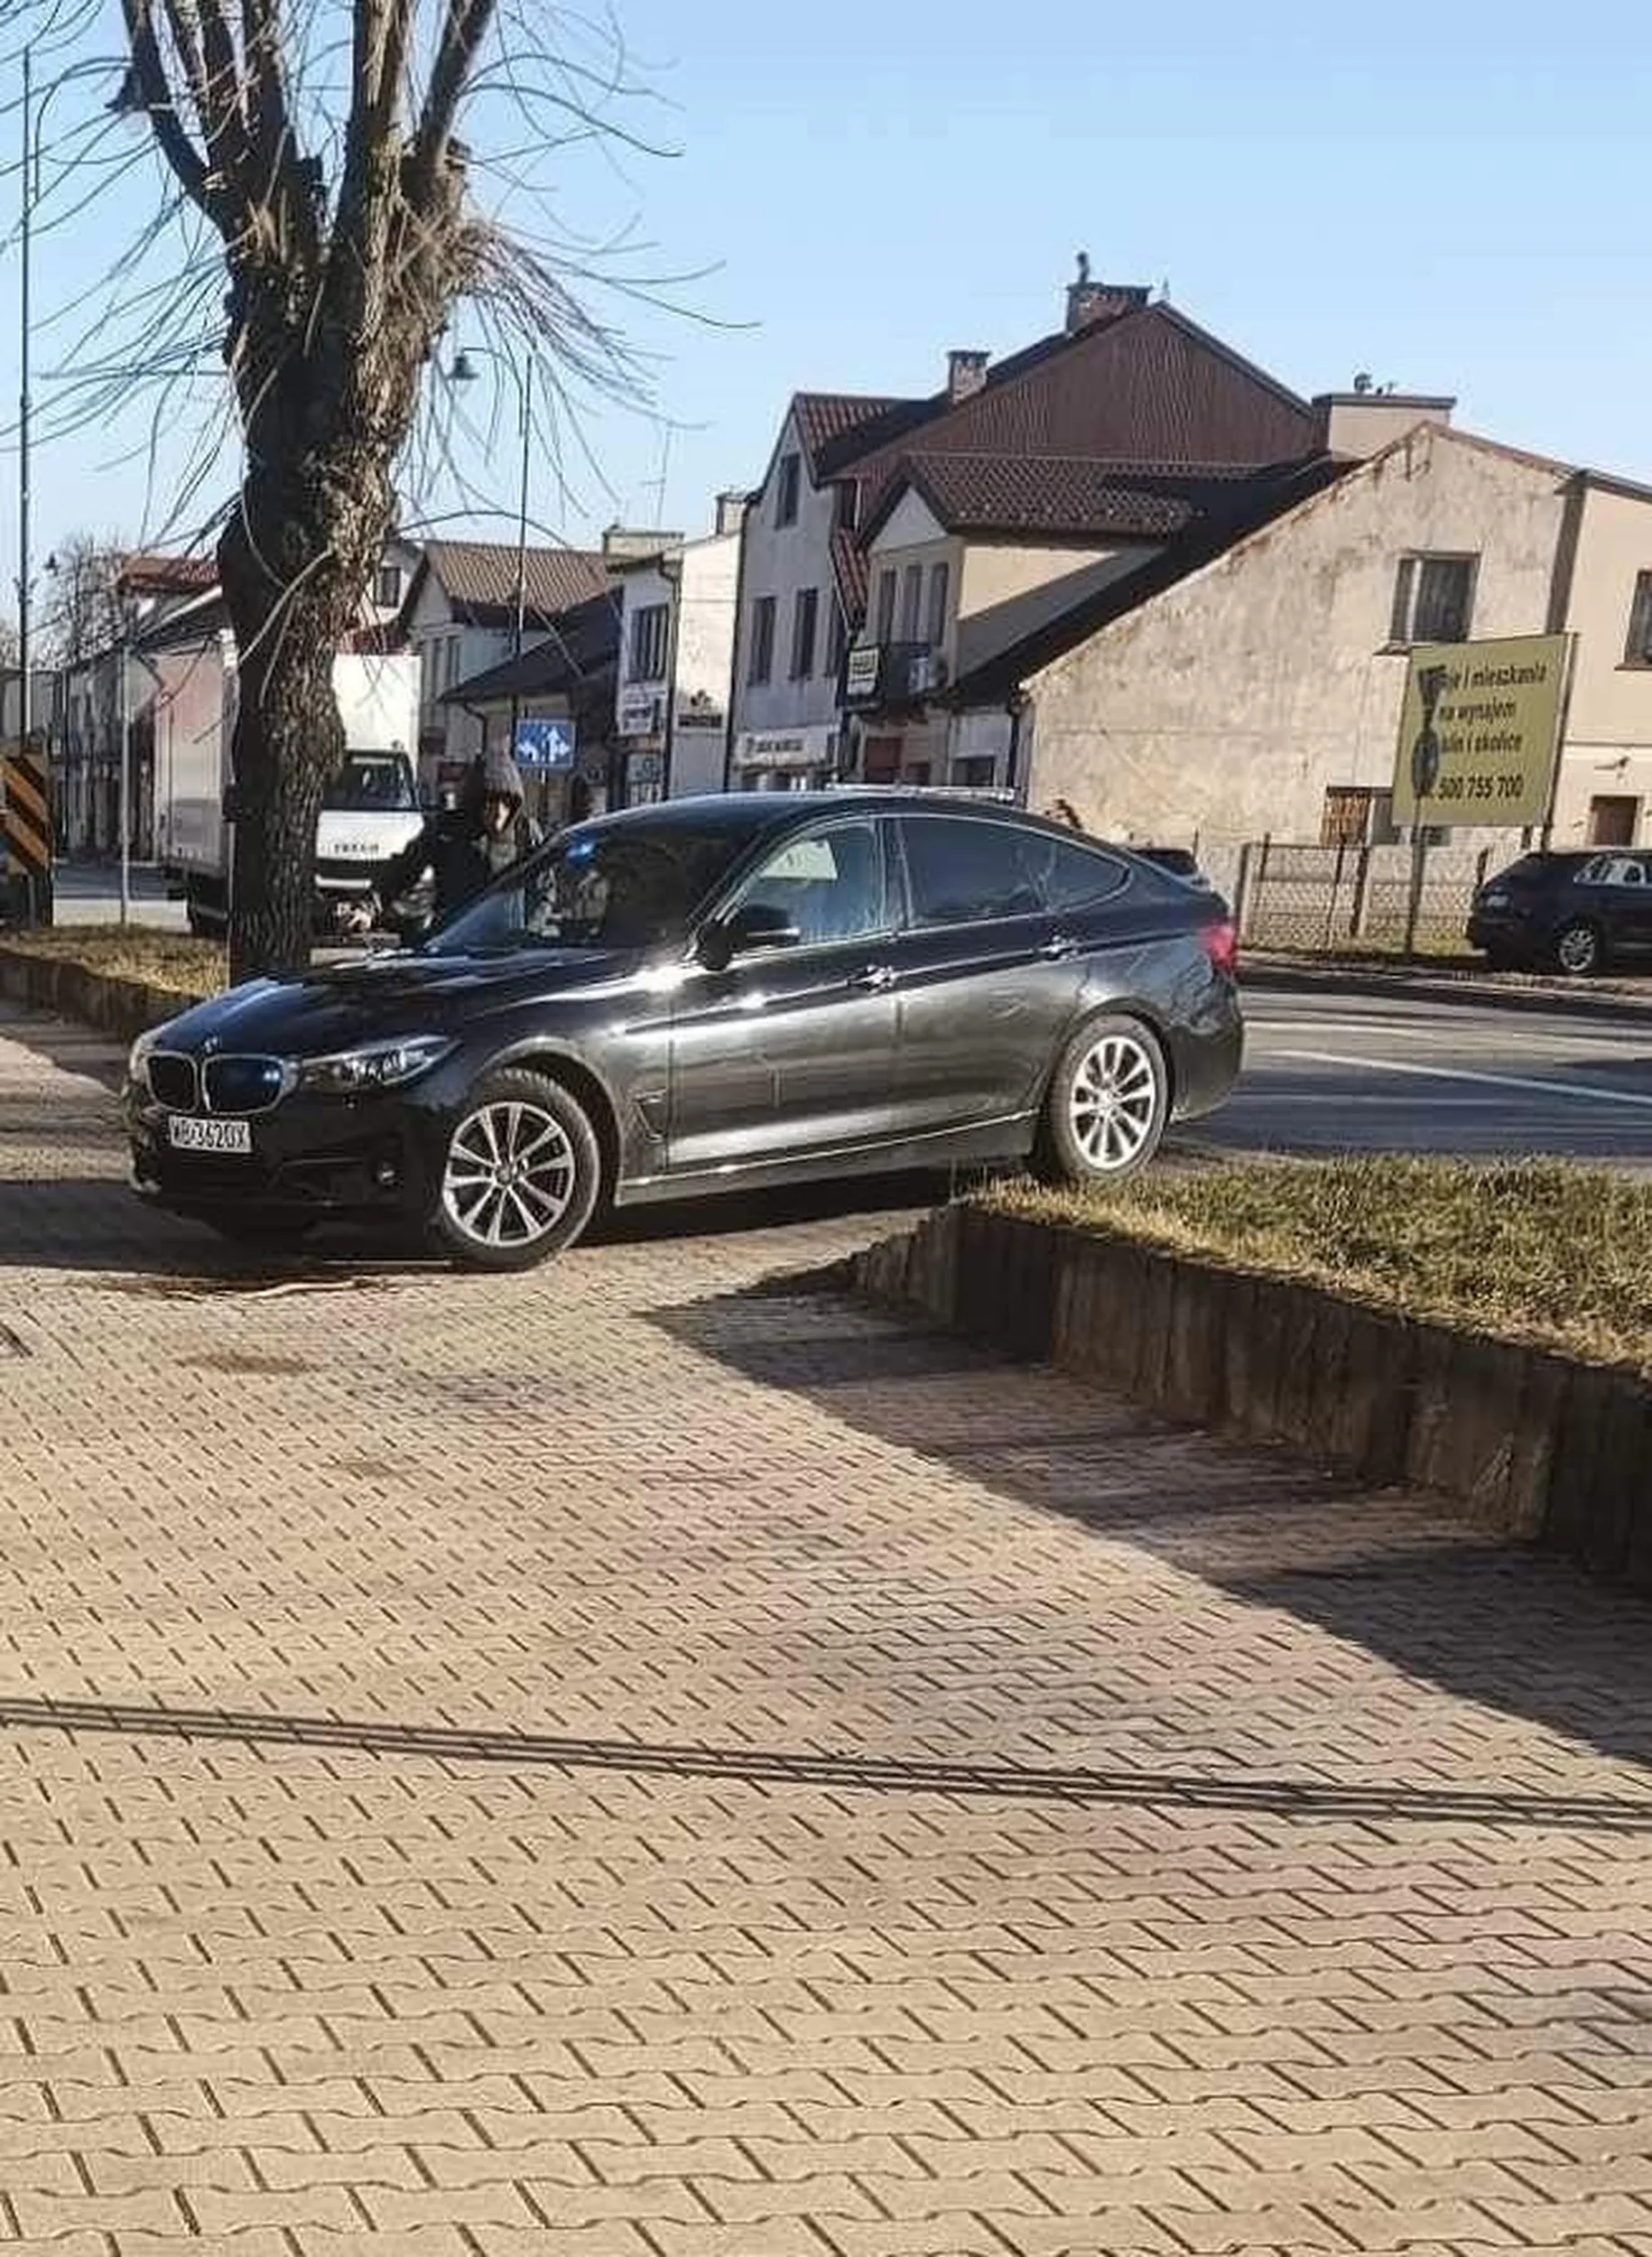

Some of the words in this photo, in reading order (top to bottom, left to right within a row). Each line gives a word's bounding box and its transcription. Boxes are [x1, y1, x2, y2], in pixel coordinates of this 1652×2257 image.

[1457, 696, 1517, 725] wynajem
[1468, 775, 1494, 799] 755
[1498, 774, 1525, 798] 700
